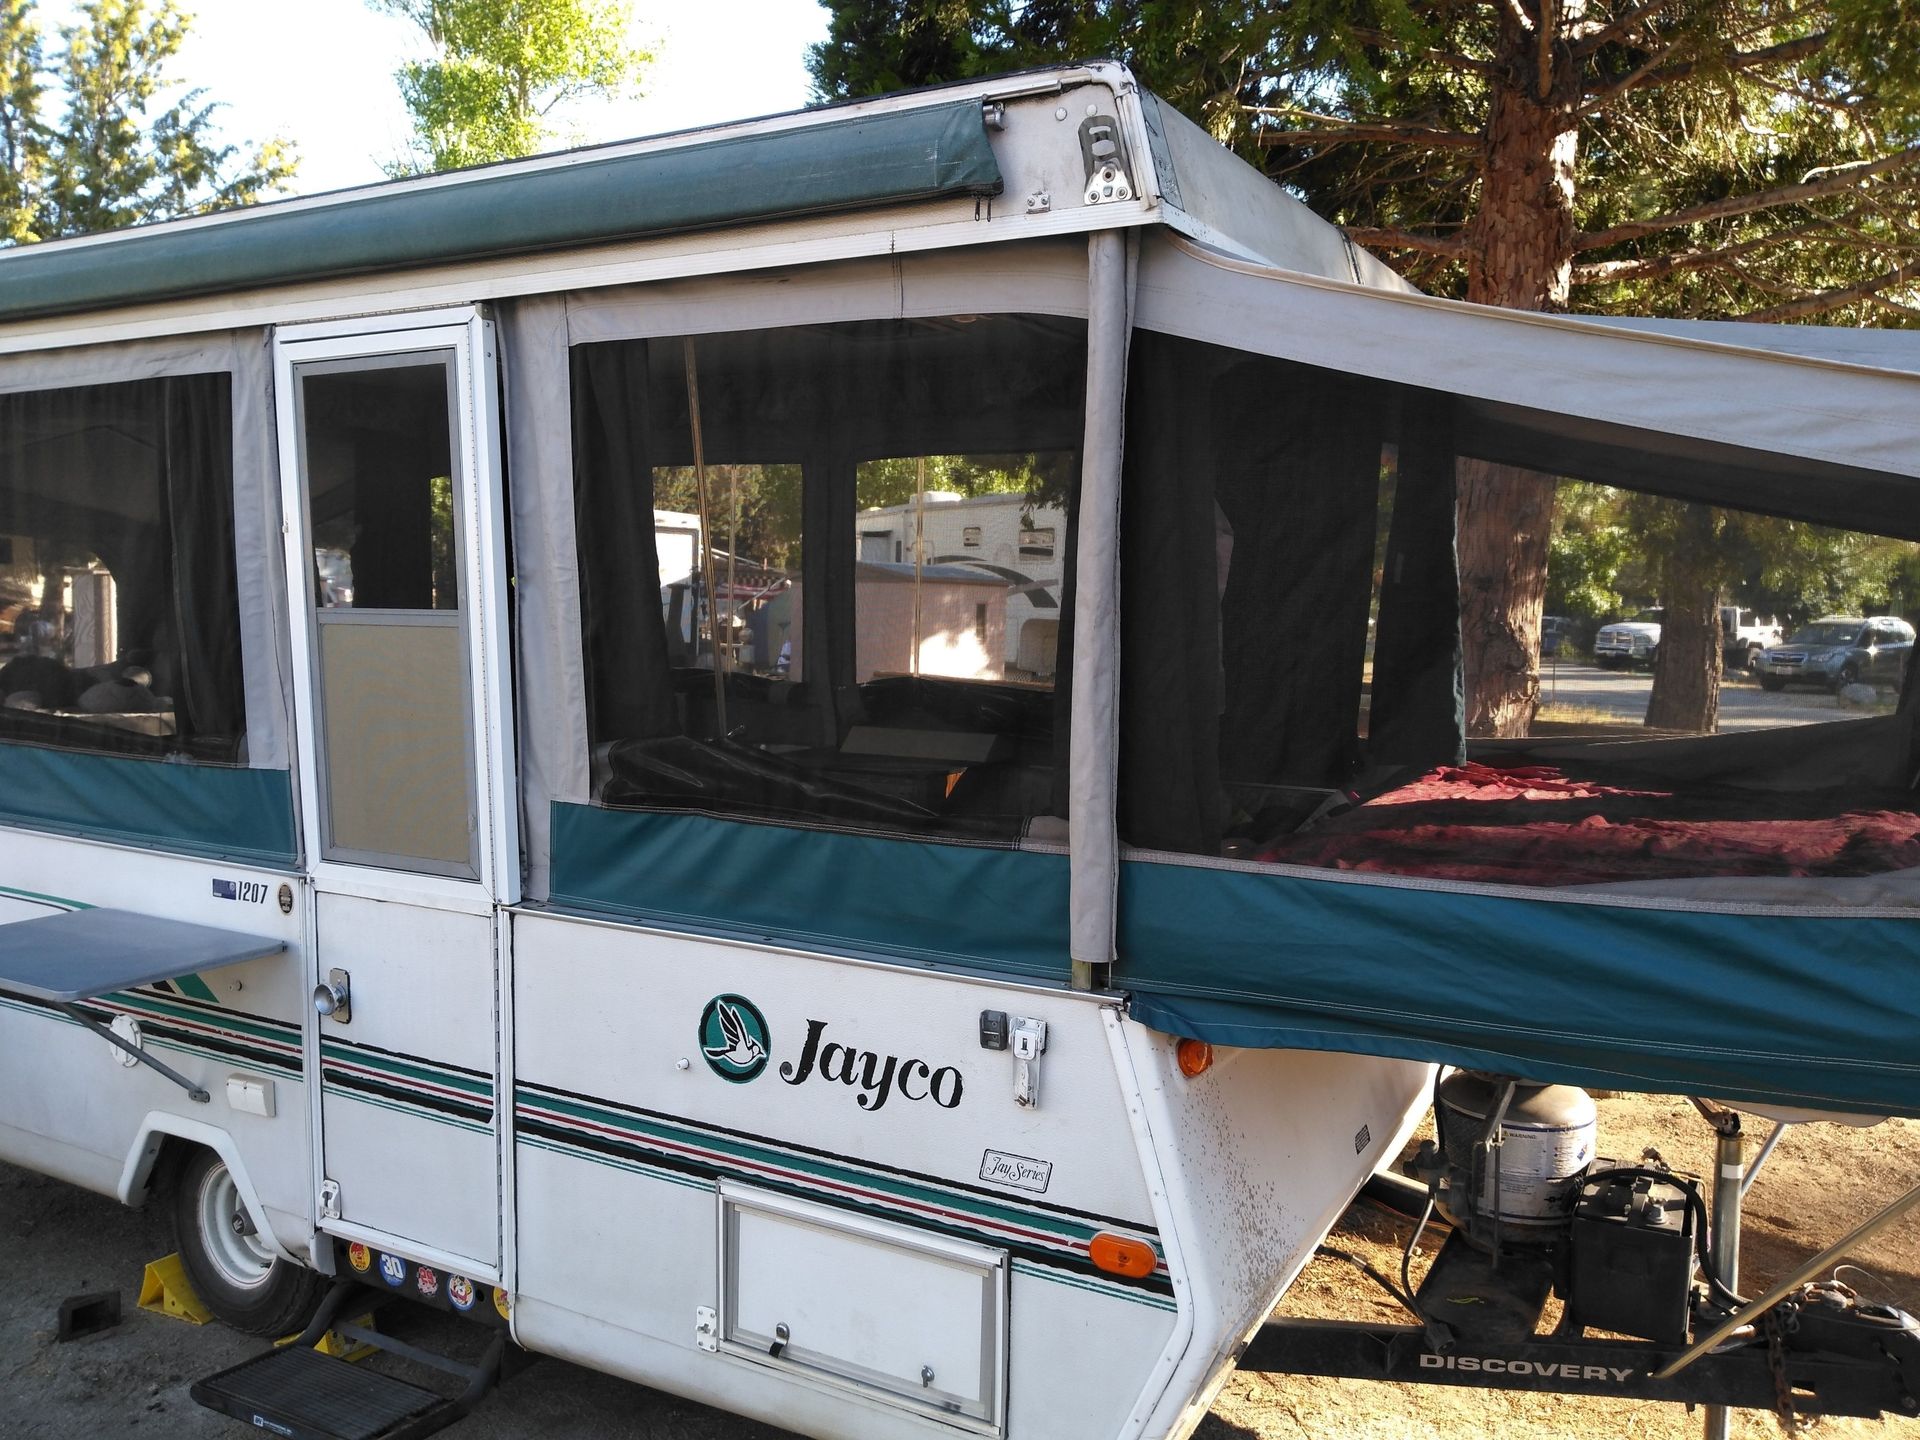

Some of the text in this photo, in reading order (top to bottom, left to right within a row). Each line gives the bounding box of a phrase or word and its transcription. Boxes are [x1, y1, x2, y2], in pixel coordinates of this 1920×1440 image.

[238, 881, 268, 904] 1207
[779, 1018, 964, 1111] Jayco
[985, 1156, 1046, 1182] Jay Series
[381, 1253, 404, 1279] 30
[1419, 1353, 1634, 1382] DISCOVERY
